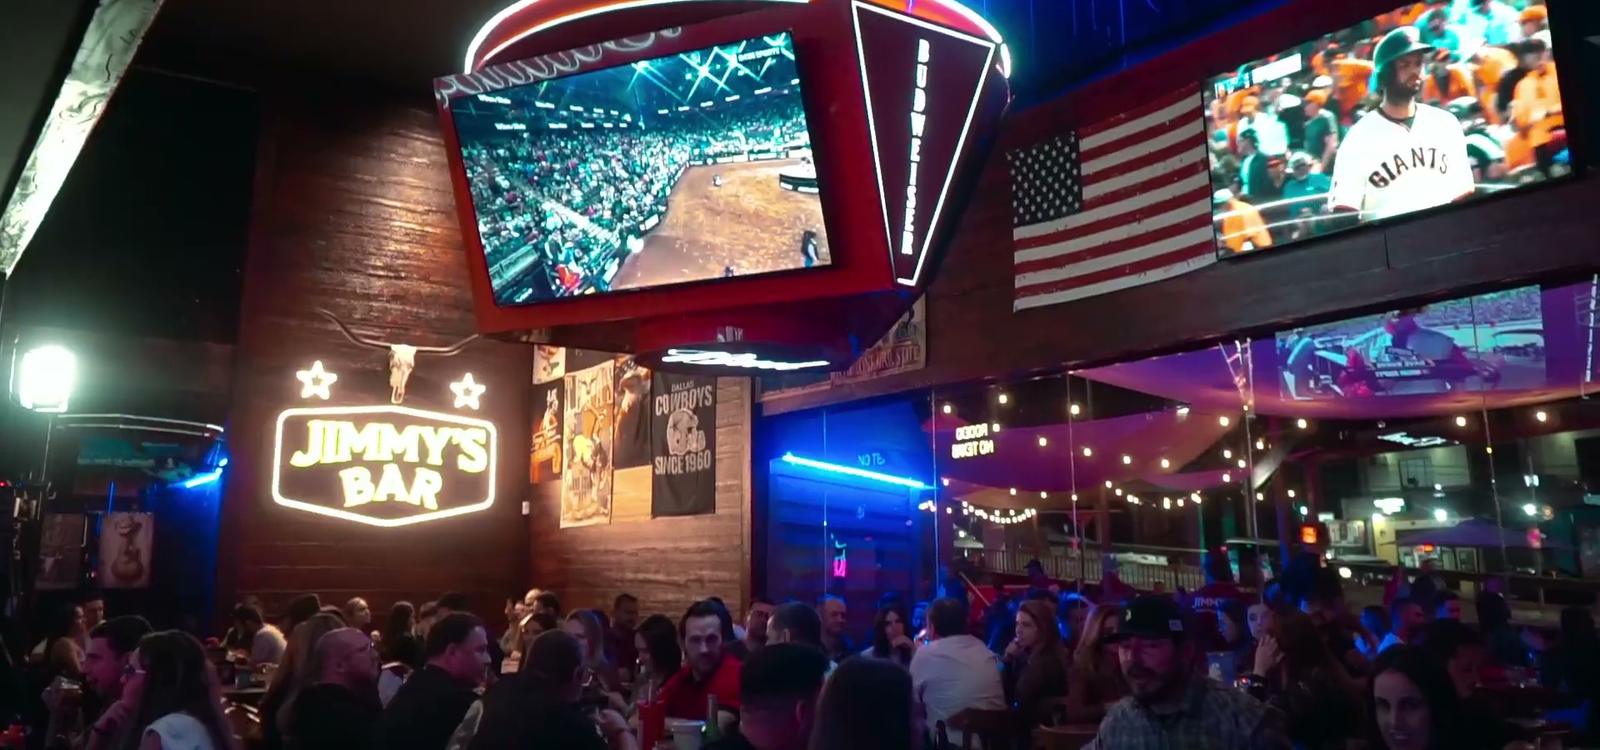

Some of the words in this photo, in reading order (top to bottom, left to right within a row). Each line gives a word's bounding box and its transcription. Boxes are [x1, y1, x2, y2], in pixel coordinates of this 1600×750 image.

[902, 39, 930, 254] BUDWEISER
[1368, 147, 1448, 188] GIANTS
[655, 385, 713, 416] COWBOYS
[672, 380, 694, 392] DALLAS
[290, 418, 488, 473] JIMMY'S
[655, 454, 684, 476] SINCE
[685, 450, 711, 473] 1960
[338, 463, 443, 511] BAR
